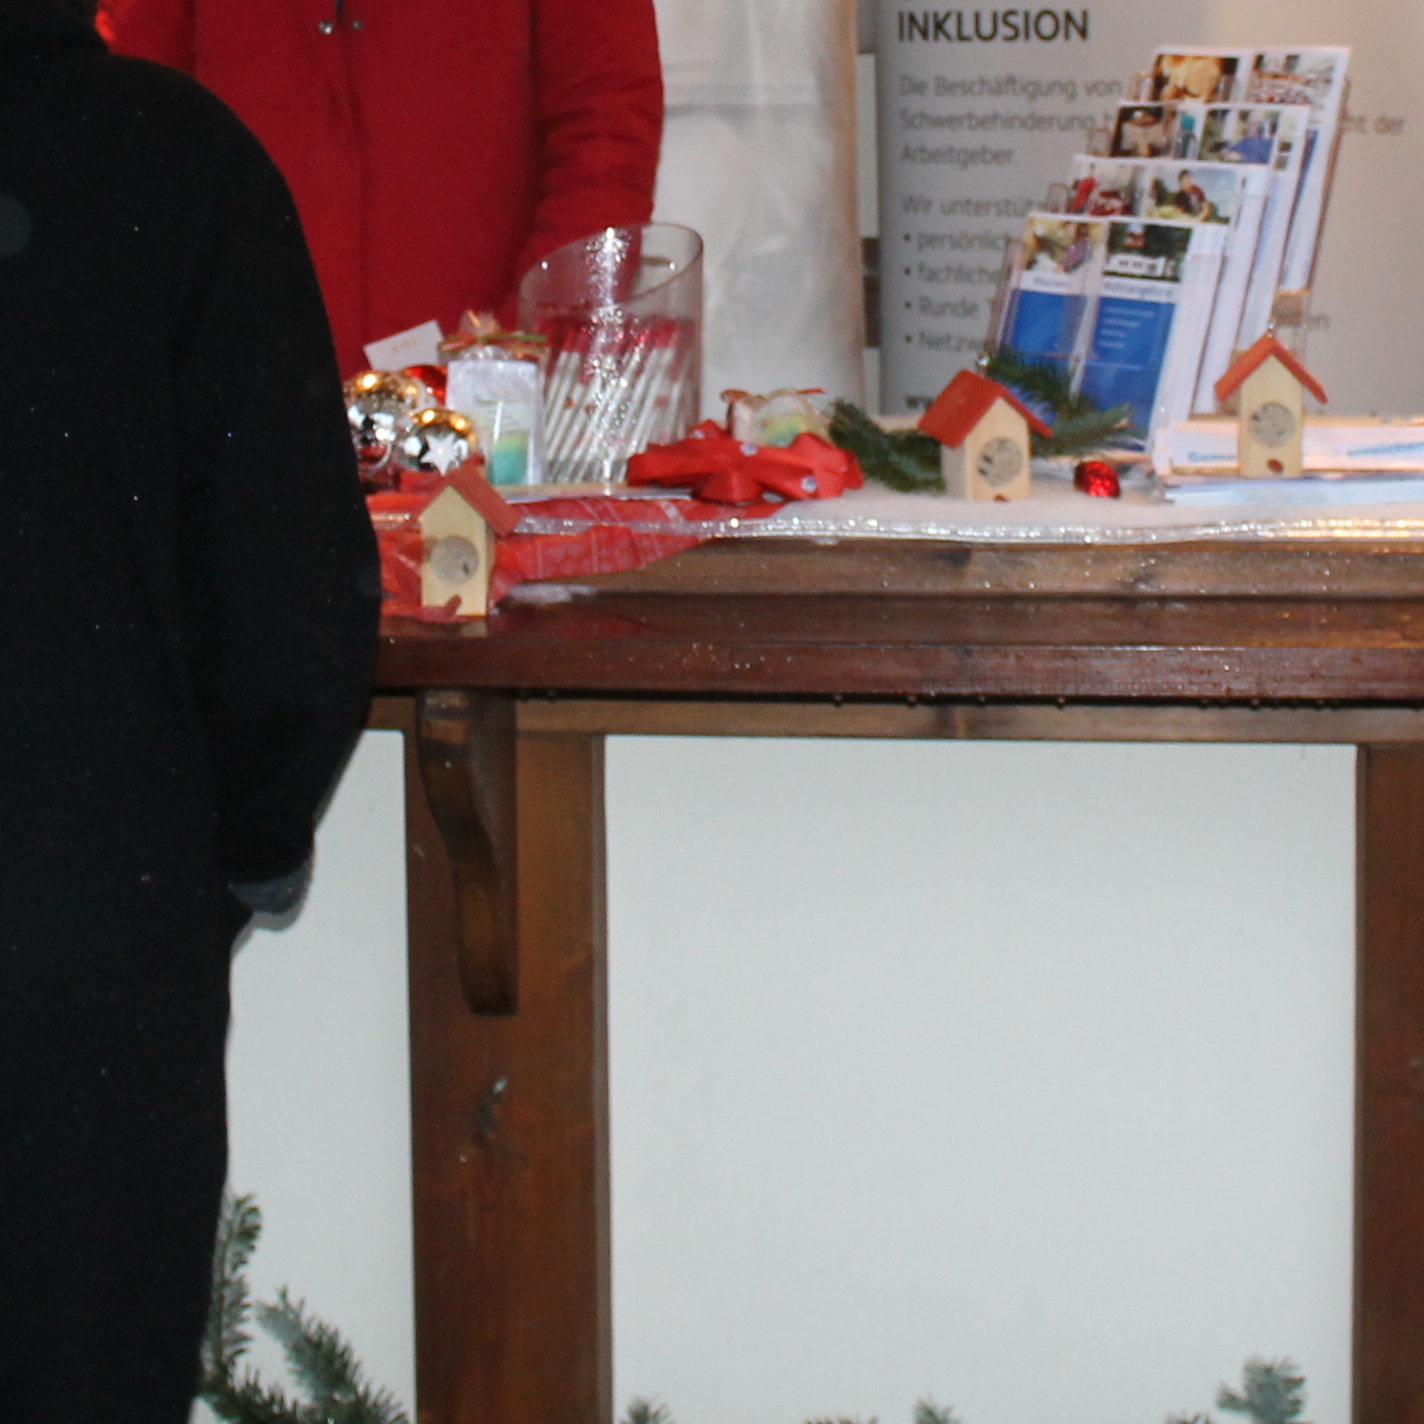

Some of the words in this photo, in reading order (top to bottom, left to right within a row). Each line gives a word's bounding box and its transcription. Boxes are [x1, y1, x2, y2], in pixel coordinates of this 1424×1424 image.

[897, 8, 1089, 43] INKLUSION
[900, 75, 928, 97] Die
[934, 73, 1077, 103] Beschäftigung
[1084, 79, 1122, 98] von
